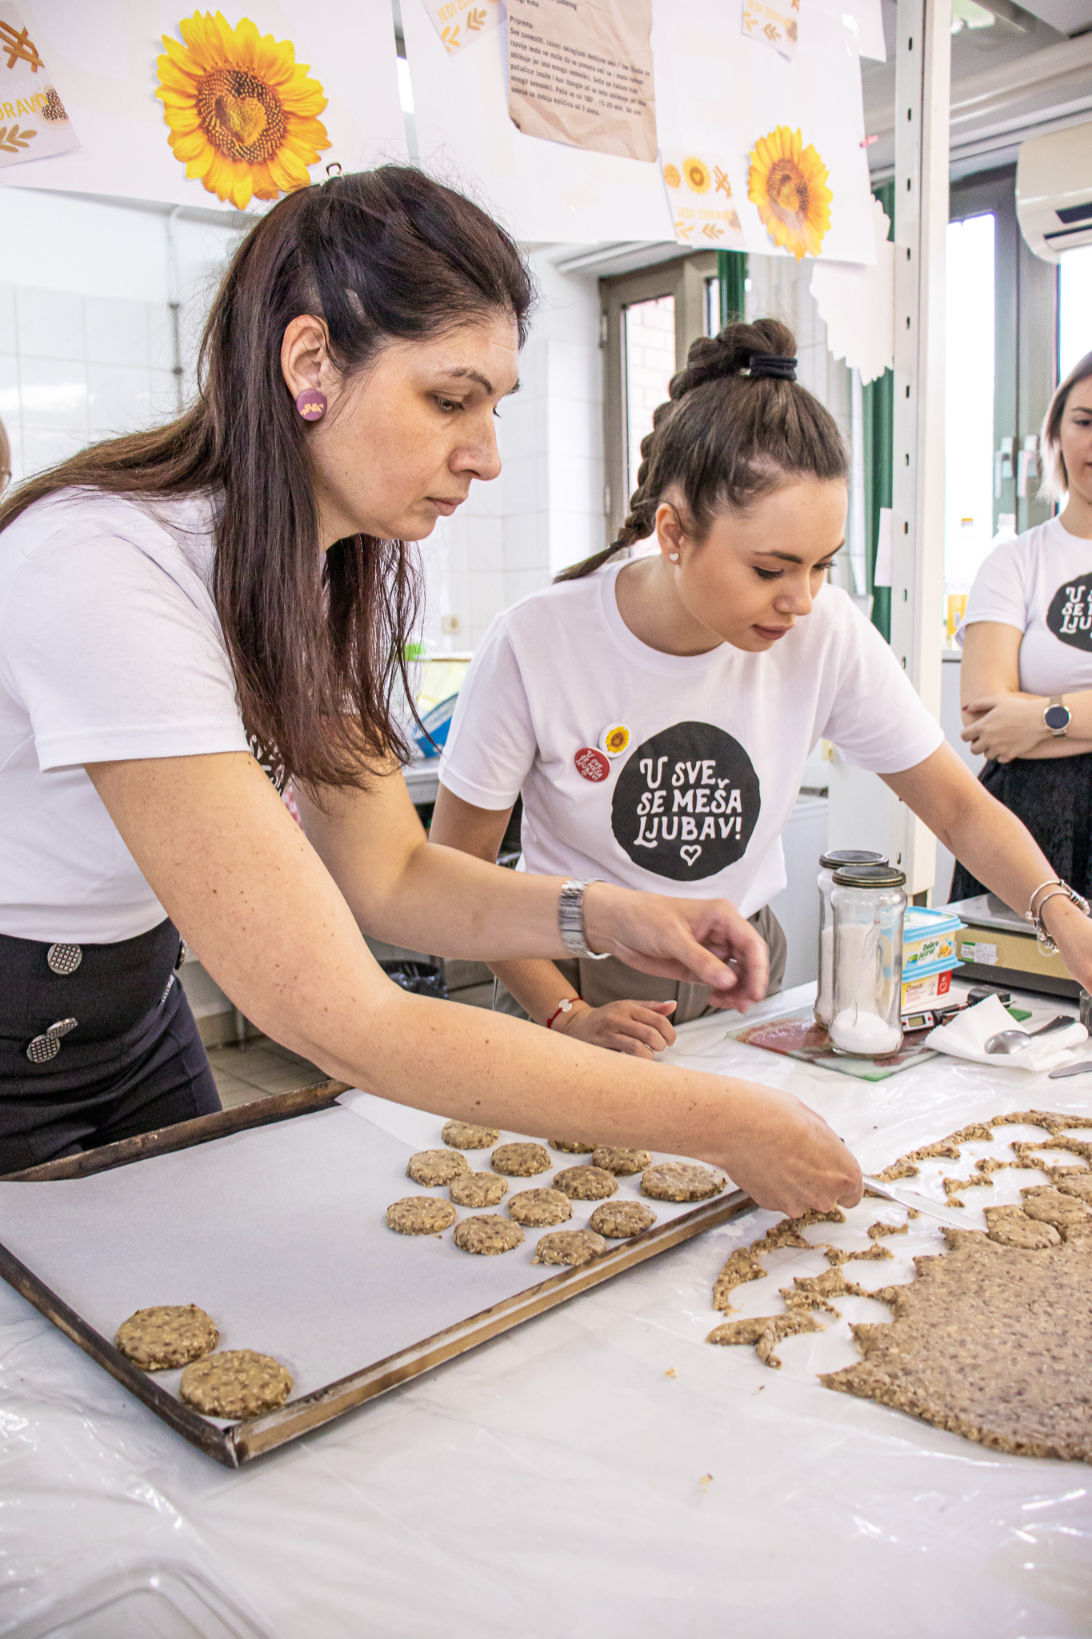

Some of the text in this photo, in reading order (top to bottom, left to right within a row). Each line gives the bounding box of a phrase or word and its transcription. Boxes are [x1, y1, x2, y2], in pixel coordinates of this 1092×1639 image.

[639, 755, 716, 789] U SVE
[637, 778, 743, 815] SE MEŠA
[633, 816, 743, 848] LJUBAV!
